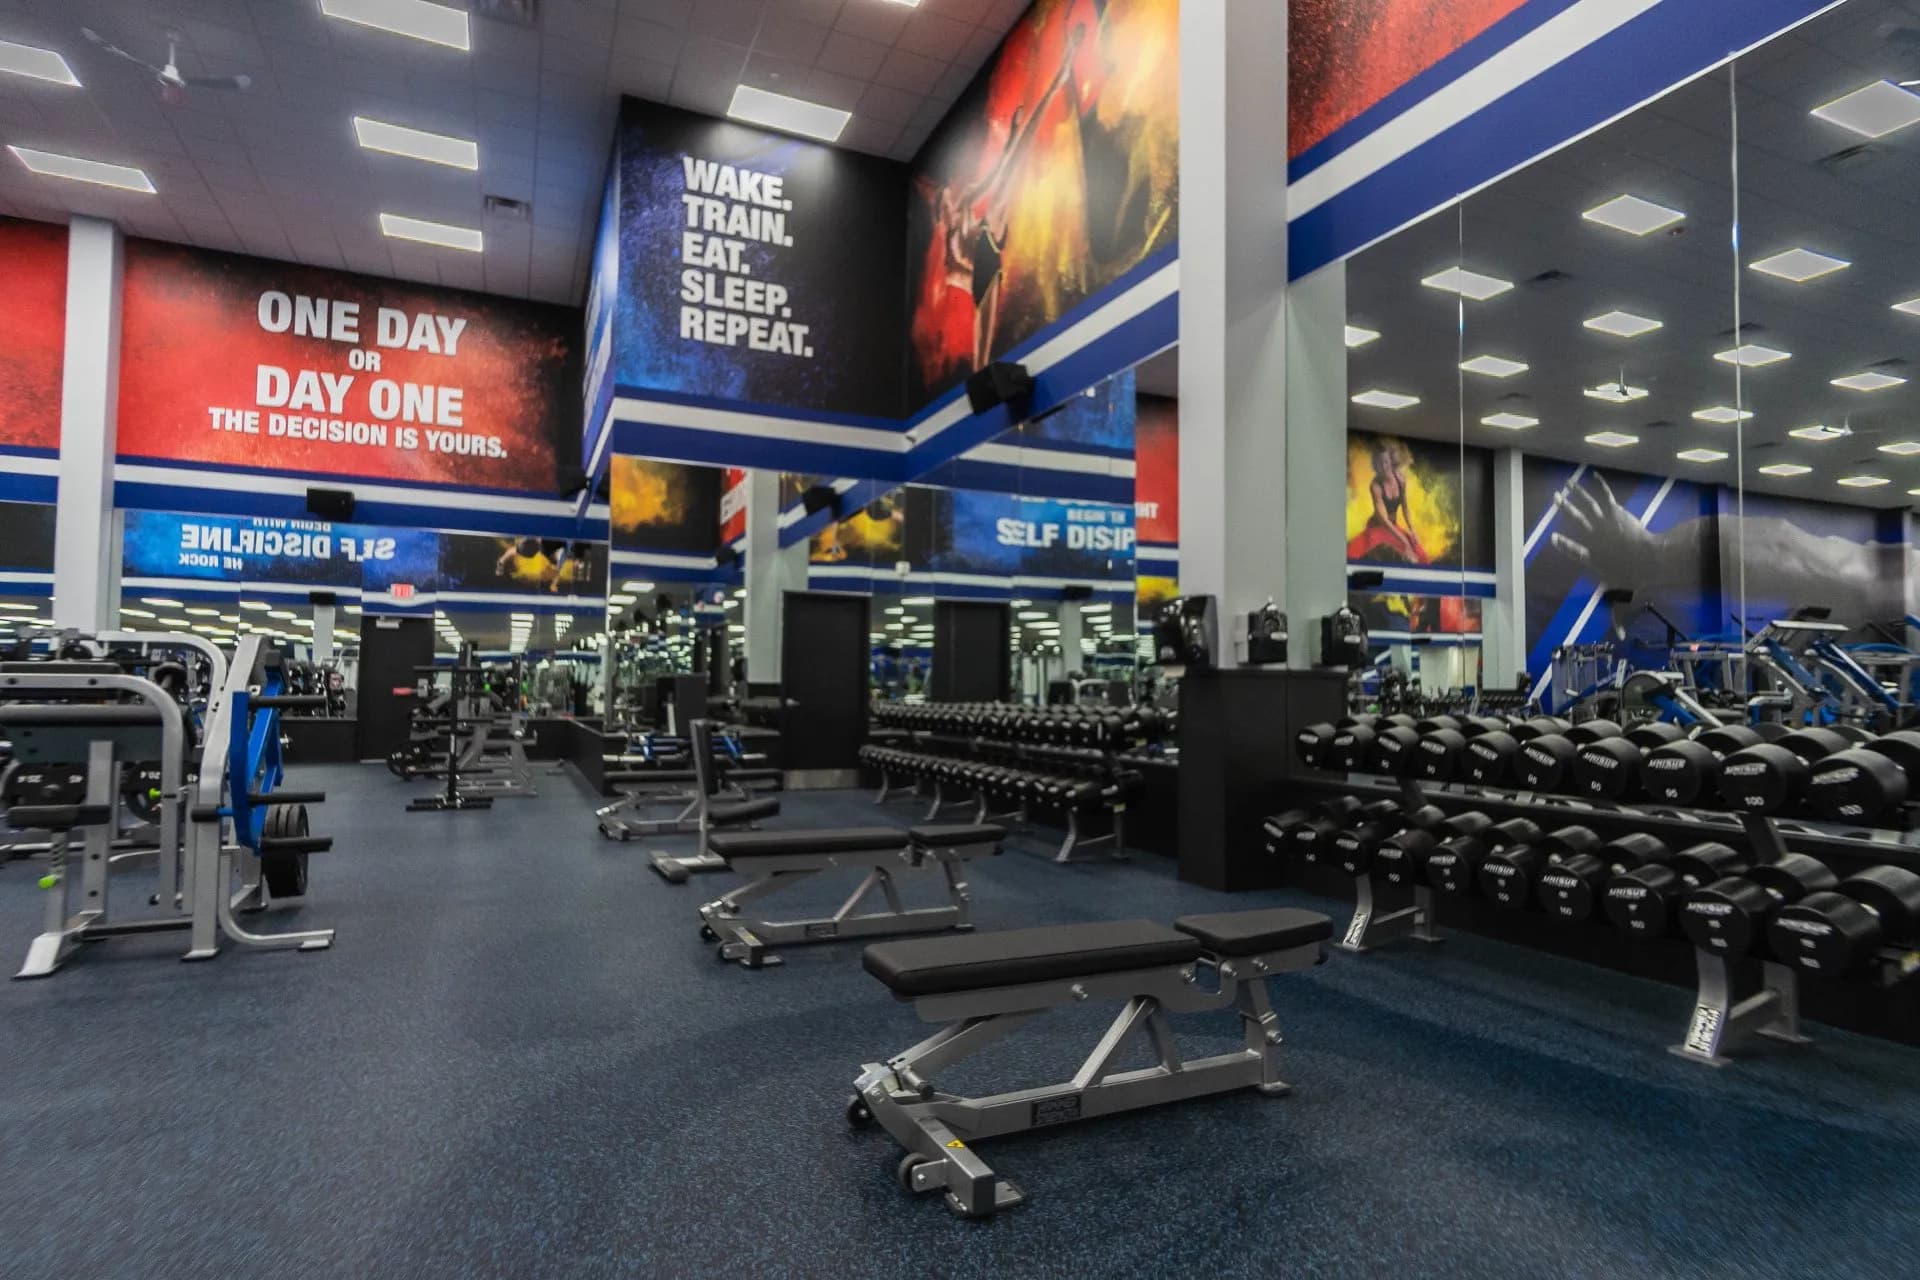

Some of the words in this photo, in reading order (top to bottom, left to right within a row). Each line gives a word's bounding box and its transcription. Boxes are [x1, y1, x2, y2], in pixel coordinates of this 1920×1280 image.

[682, 156, 793, 211] WAKE.
[681, 193, 793, 247] TRAIN.
[682, 231, 750, 274] EAT.
[680, 269, 792, 318] SLEEP.
[257, 290, 359, 343] ONE
[377, 305, 467, 356] DAY
[680, 305, 814, 358] REPEAT.
[348, 349, 381, 373] OR
[256, 364, 354, 415] DAY
[368, 379, 464, 428] ONE
[208, 406, 259, 435] THE
[268, 414, 387, 447] DECISION
[395, 426, 418, 450] IS
[424, 430, 507, 459] YOURS.
[996, 517, 1060, 547] SELF
